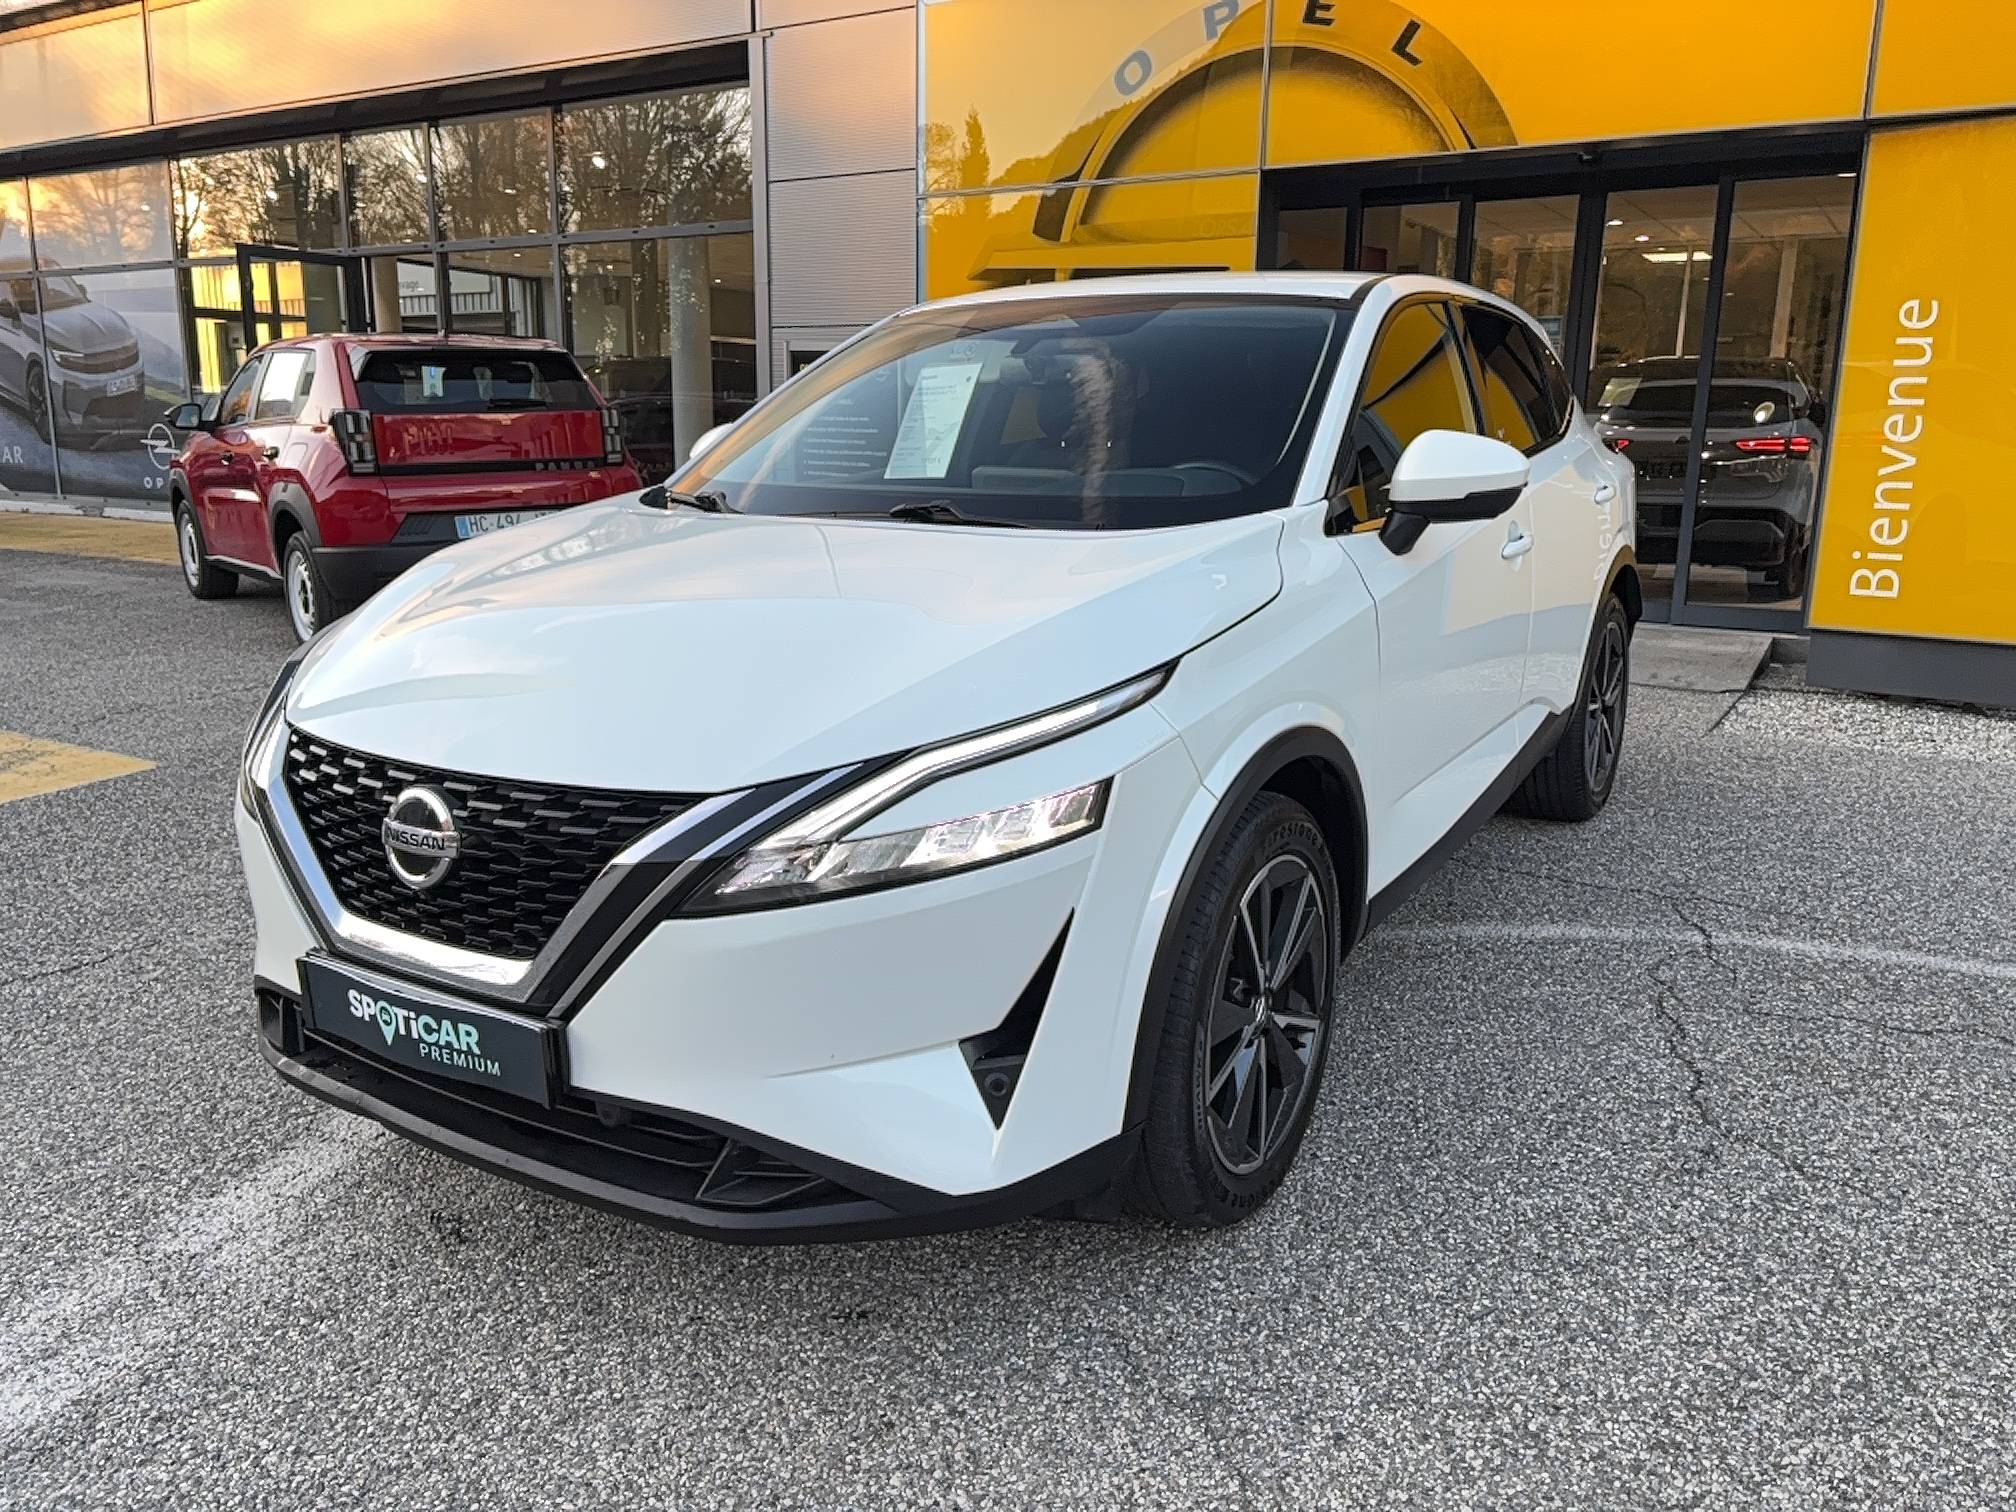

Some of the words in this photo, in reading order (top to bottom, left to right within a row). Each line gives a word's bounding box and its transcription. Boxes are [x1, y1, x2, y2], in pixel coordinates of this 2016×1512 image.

[1849, 298, 1939, 599] Bienvenue
[386, 826, 445, 850] NISSAN
[419, 1042, 501, 1077] PREMIUM
